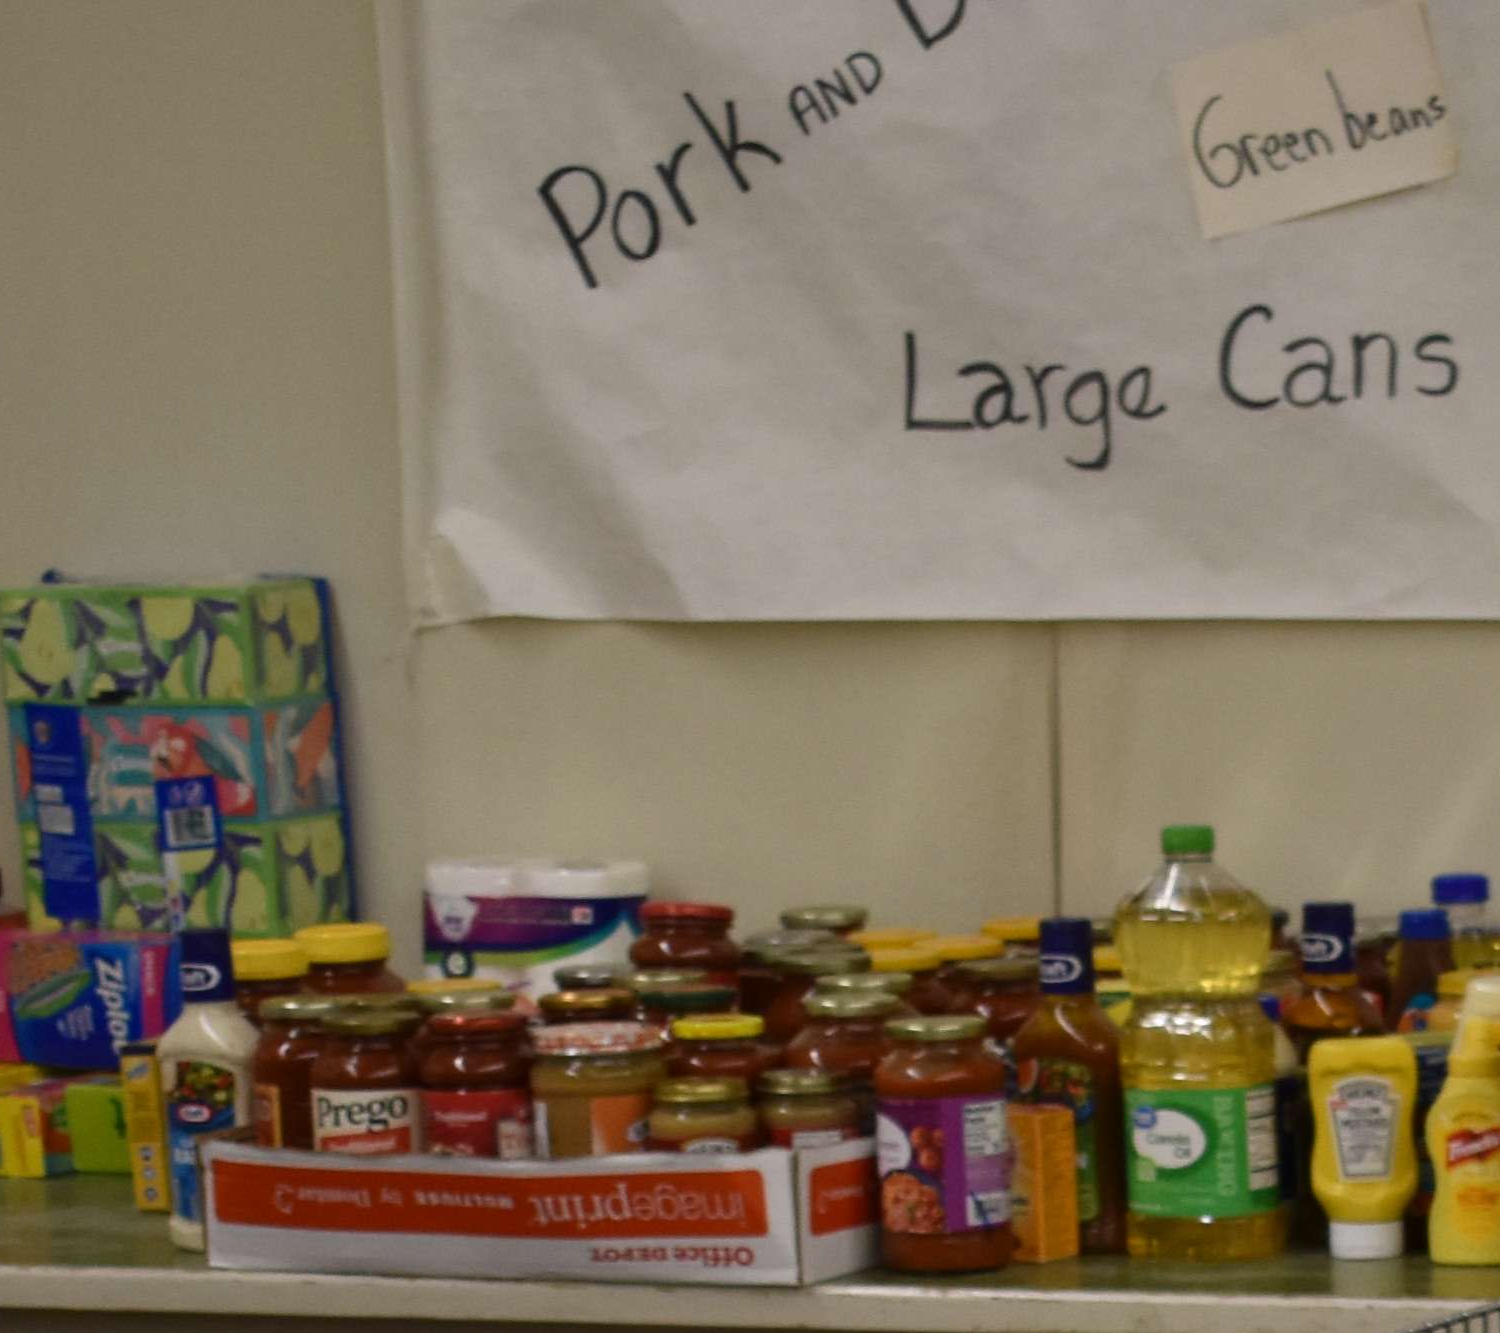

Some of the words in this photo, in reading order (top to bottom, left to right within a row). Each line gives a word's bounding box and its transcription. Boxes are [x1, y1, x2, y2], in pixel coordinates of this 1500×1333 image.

[1190, 90, 1336, 196] Green
[1330, 69, 1450, 162] beans
[536, 94, 786, 292] Pork
[786, 48, 886, 138] AND
[900, 322, 1168, 470] Large
[1218, 303, 1462, 416] Cans
[315, 1096, 408, 1135] Prego
[526, 1182, 745, 1234] imageprint
[590, 1247, 667, 1265] DEPOT
[675, 1245, 755, 1267] Office
